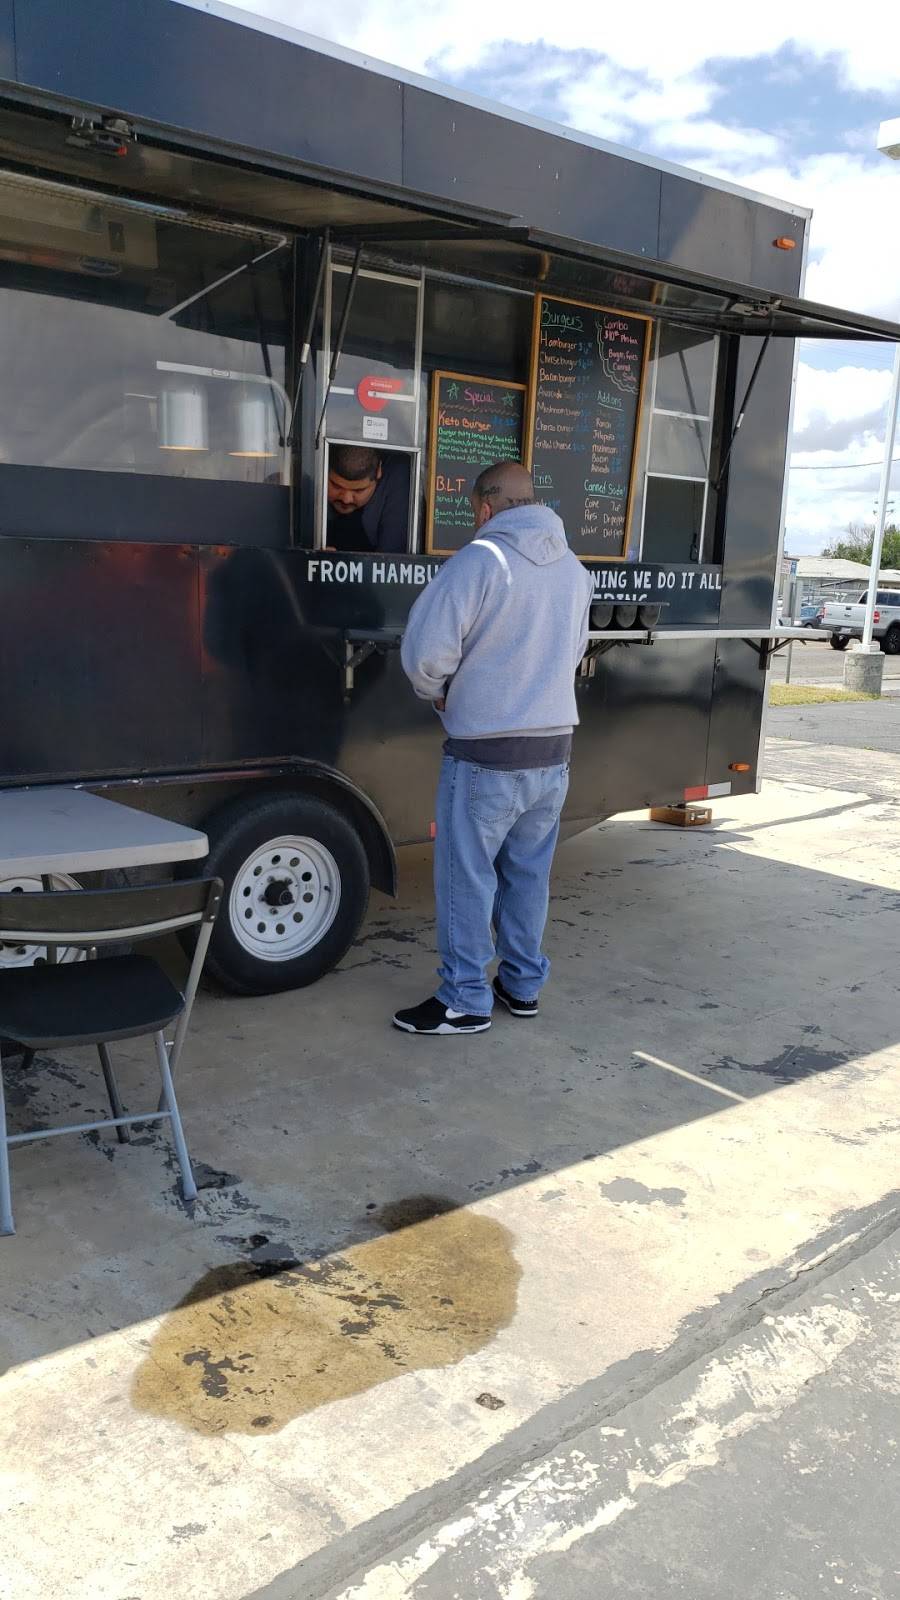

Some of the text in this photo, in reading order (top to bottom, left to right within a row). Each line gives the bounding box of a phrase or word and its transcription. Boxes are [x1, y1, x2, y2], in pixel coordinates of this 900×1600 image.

[541, 301, 584, 333] Burgers
[603, 317, 629, 331] Combo
[541, 330, 577, 352] Hamburger
[464, 387, 496, 406] Special
[439, 410, 460, 426] Keto
[462, 418, 491, 432] Burger
[307, 560, 363, 583] FROM
[634, 571, 652, 588] WE
[658, 572, 676, 589] DO
[681, 572, 695, 589] IT
[699, 573, 722, 590] ALL
